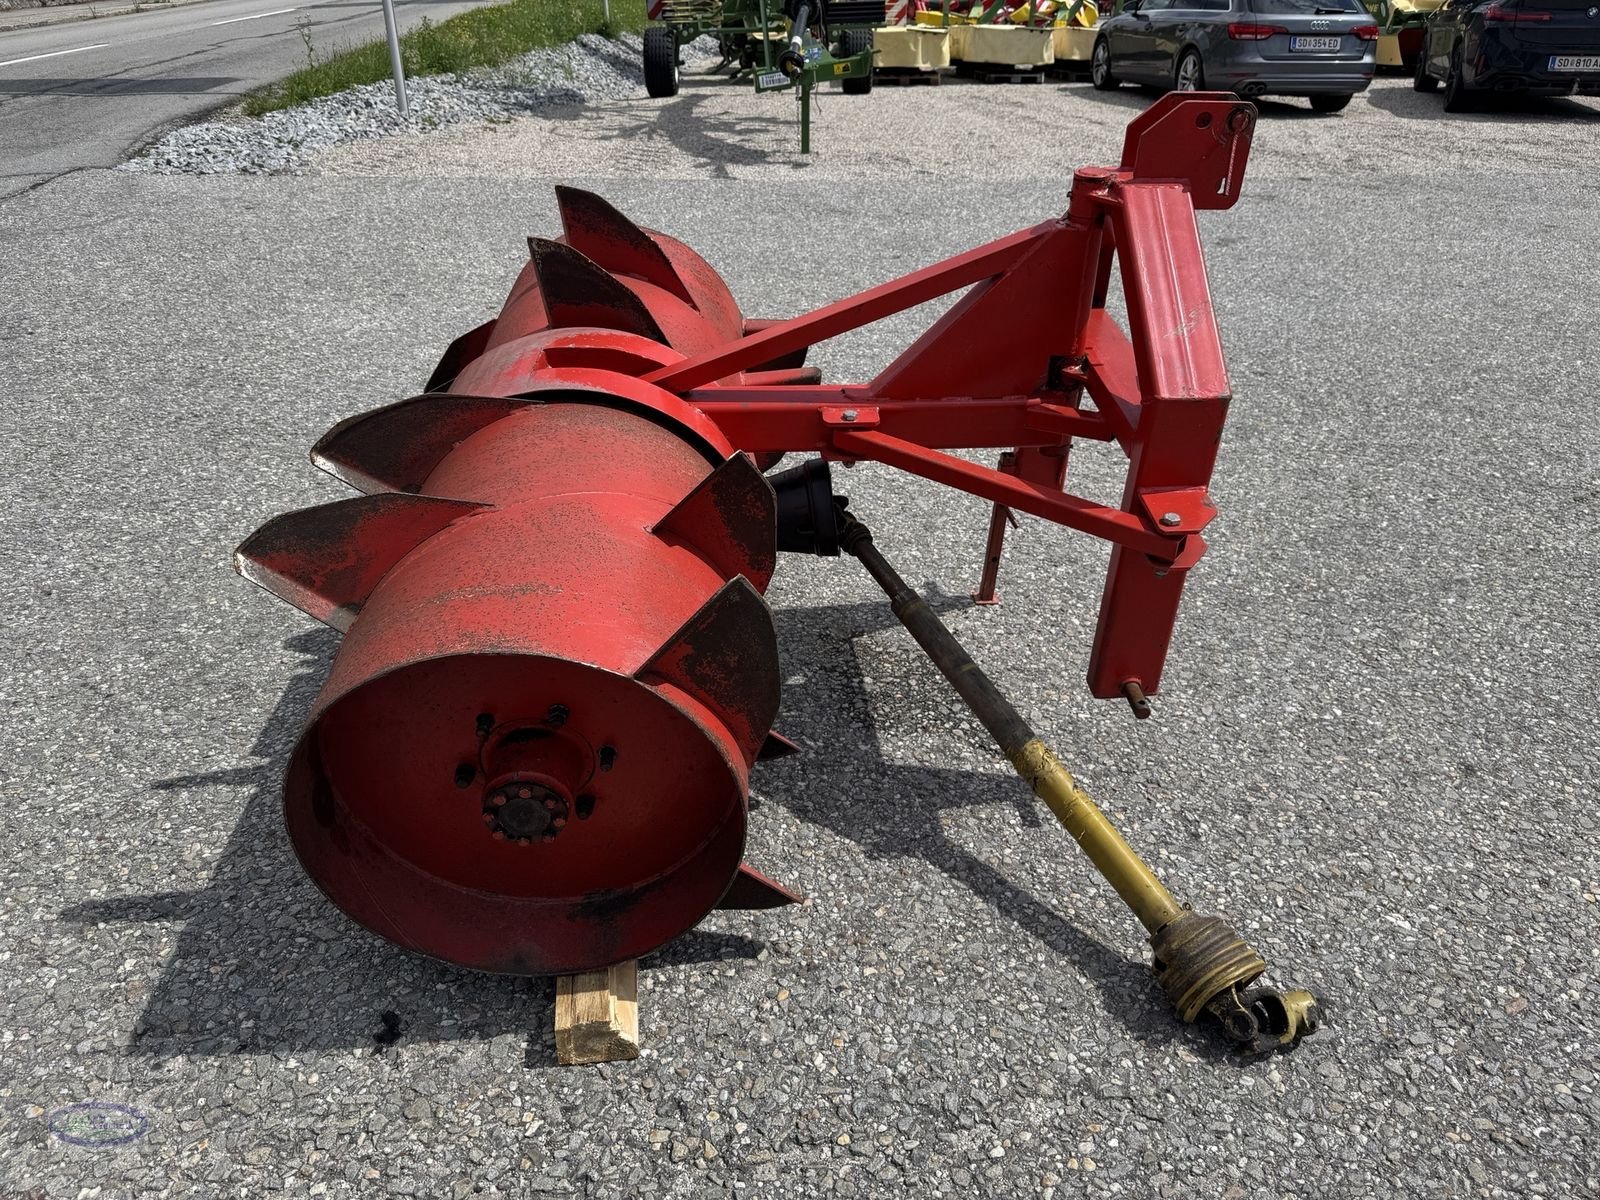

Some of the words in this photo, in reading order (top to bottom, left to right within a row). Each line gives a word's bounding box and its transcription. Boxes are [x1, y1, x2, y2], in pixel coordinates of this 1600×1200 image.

[1297, 38, 1308, 48] SD
[1557, 58, 1570, 67] SD
[1575, 58, 1592, 67] 810
[1592, 58, 1600, 67] A
